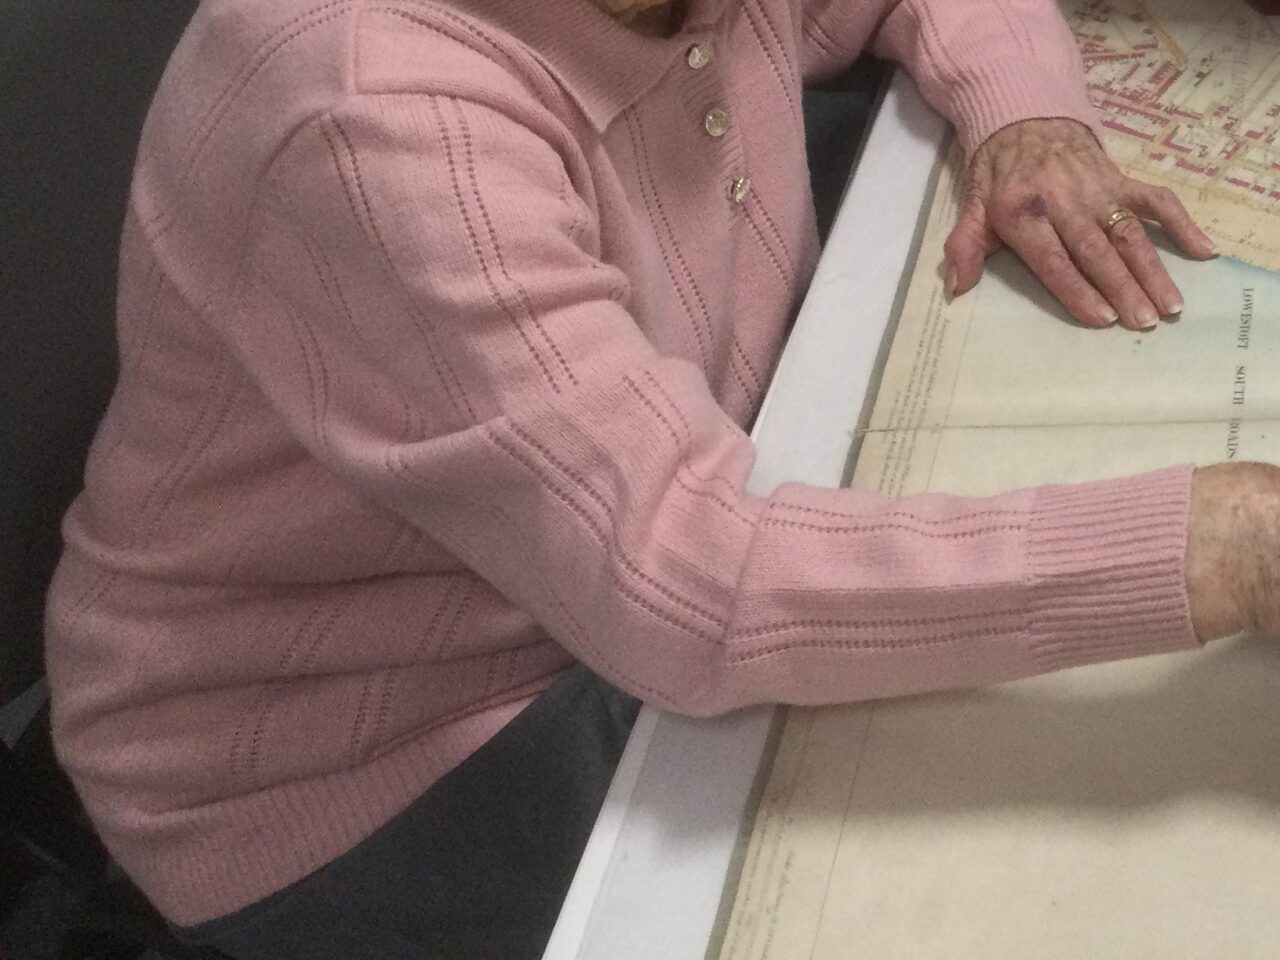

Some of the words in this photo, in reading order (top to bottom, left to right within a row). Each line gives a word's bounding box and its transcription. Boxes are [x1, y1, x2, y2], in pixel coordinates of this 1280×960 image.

[1237, 287, 1254, 350] LOWESTOFT
[1232, 365, 1247, 406] SOUTH
[1226, 416, 1242, 460] ROADS
